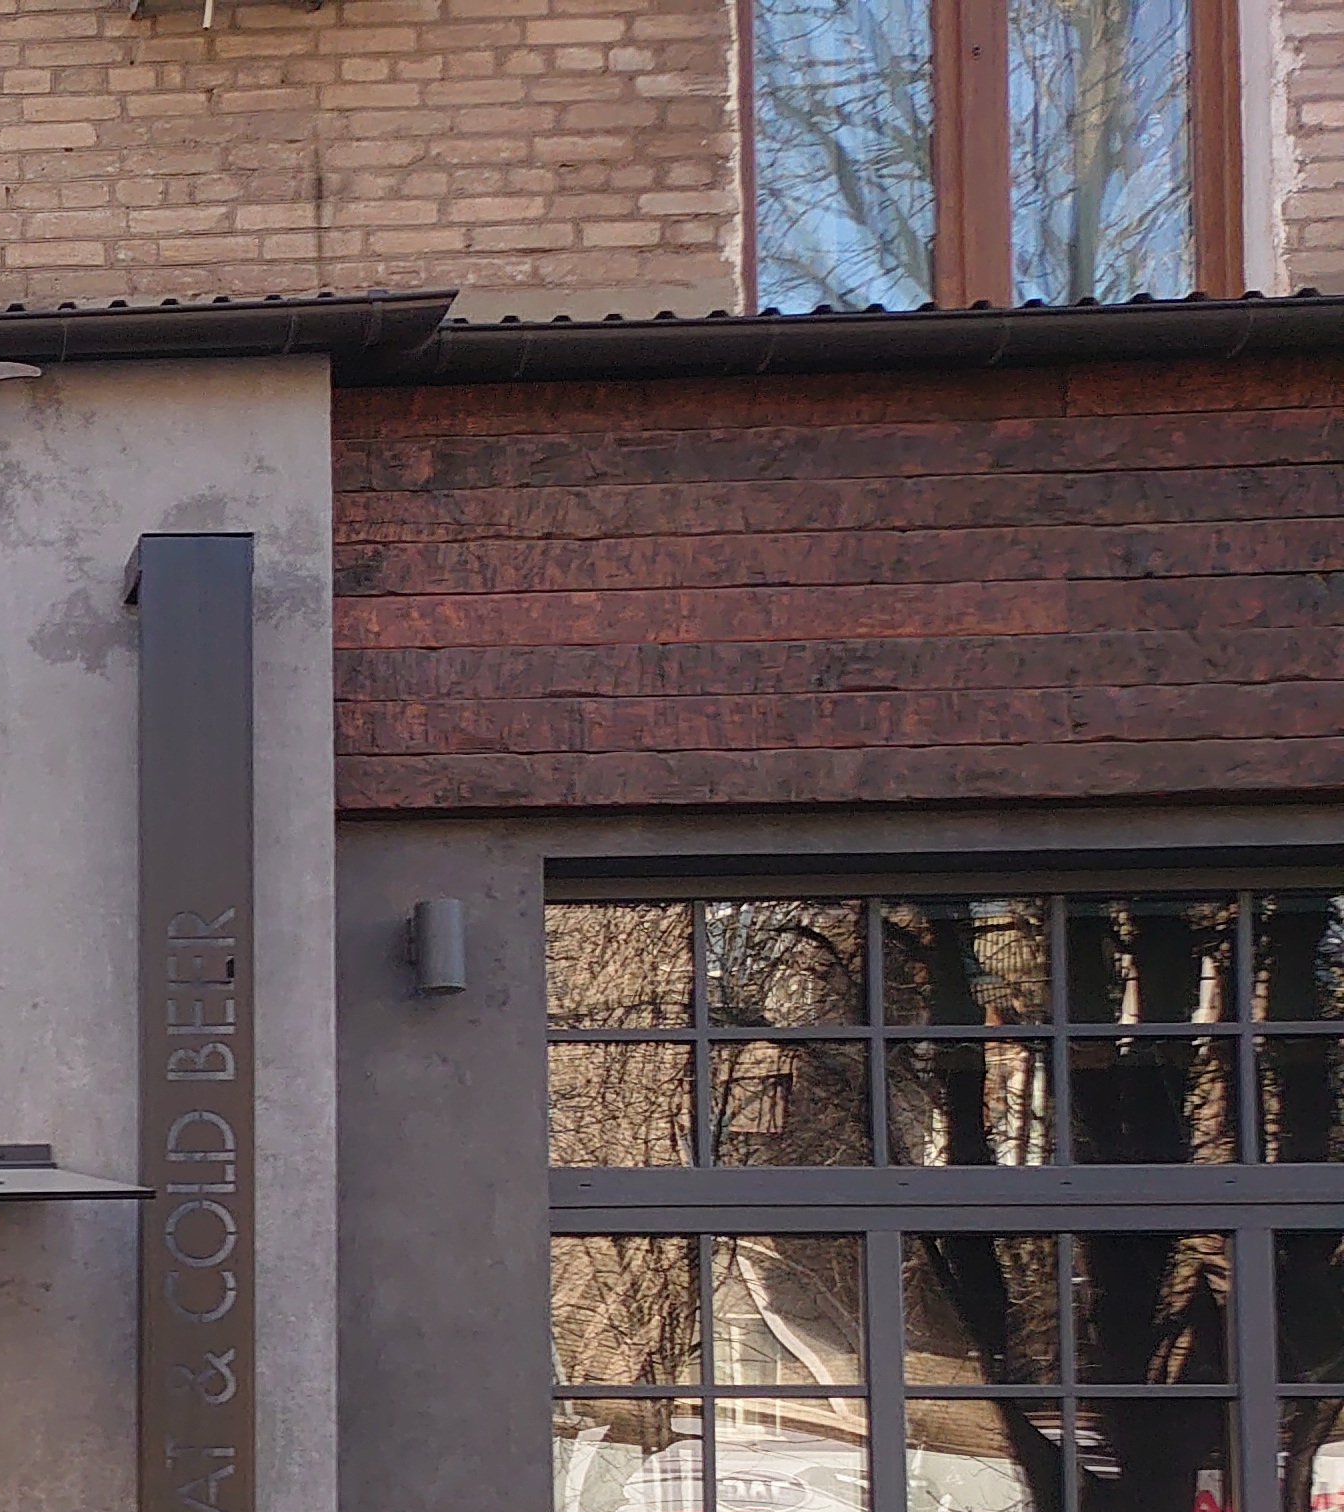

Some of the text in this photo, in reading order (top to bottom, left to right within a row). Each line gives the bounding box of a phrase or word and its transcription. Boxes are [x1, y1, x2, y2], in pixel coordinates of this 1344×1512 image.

[166, 906, 237, 1081] BEER
[166, 1109, 237, 1322] COLD
[170, 1346, 237, 1405] &
